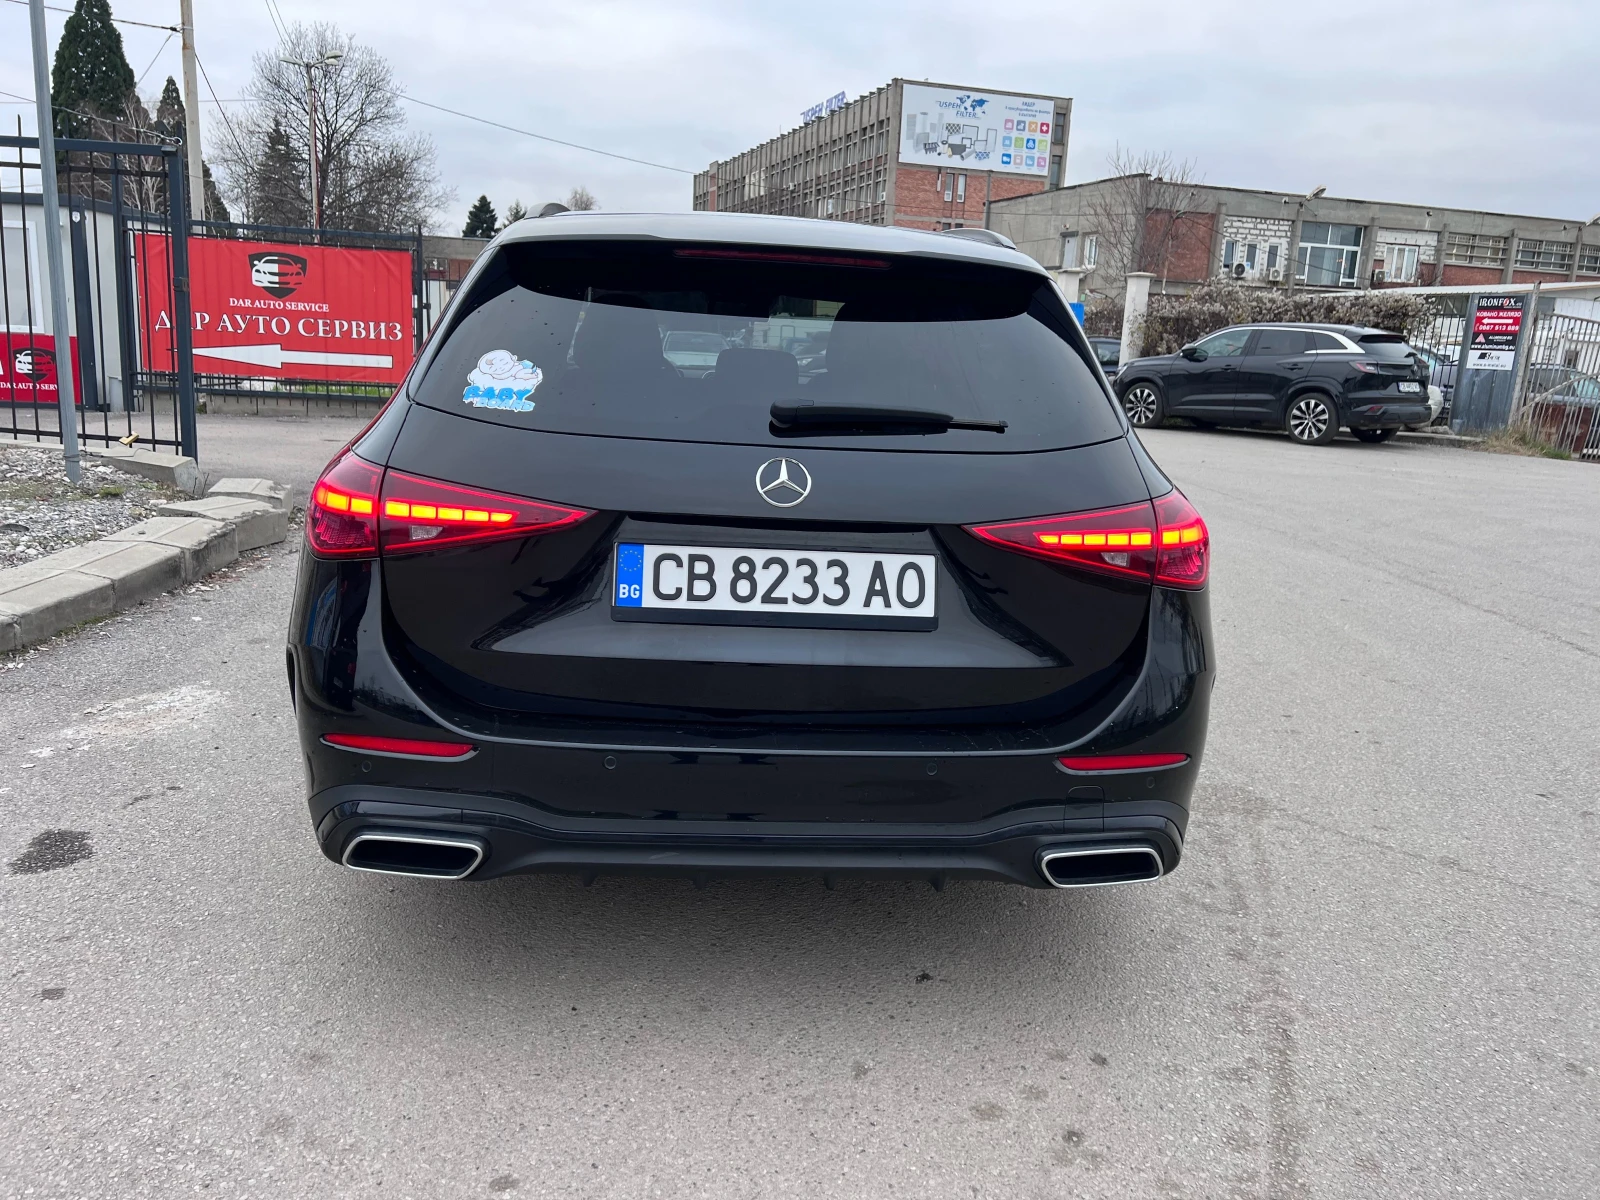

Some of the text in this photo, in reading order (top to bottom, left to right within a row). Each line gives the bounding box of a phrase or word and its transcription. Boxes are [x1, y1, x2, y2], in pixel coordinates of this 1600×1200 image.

[937, 101, 961, 109] USPEH
[229, 298, 329, 312] DAR AUTO SERVICE
[155, 310, 403, 341] ДР АУТО СЕРВИЗ
[463, 385, 533, 401] BABY
[475, 397, 536, 411] BOARD
[652, 553, 926, 609] CB 8233 AO
[619, 584, 640, 599] BG
